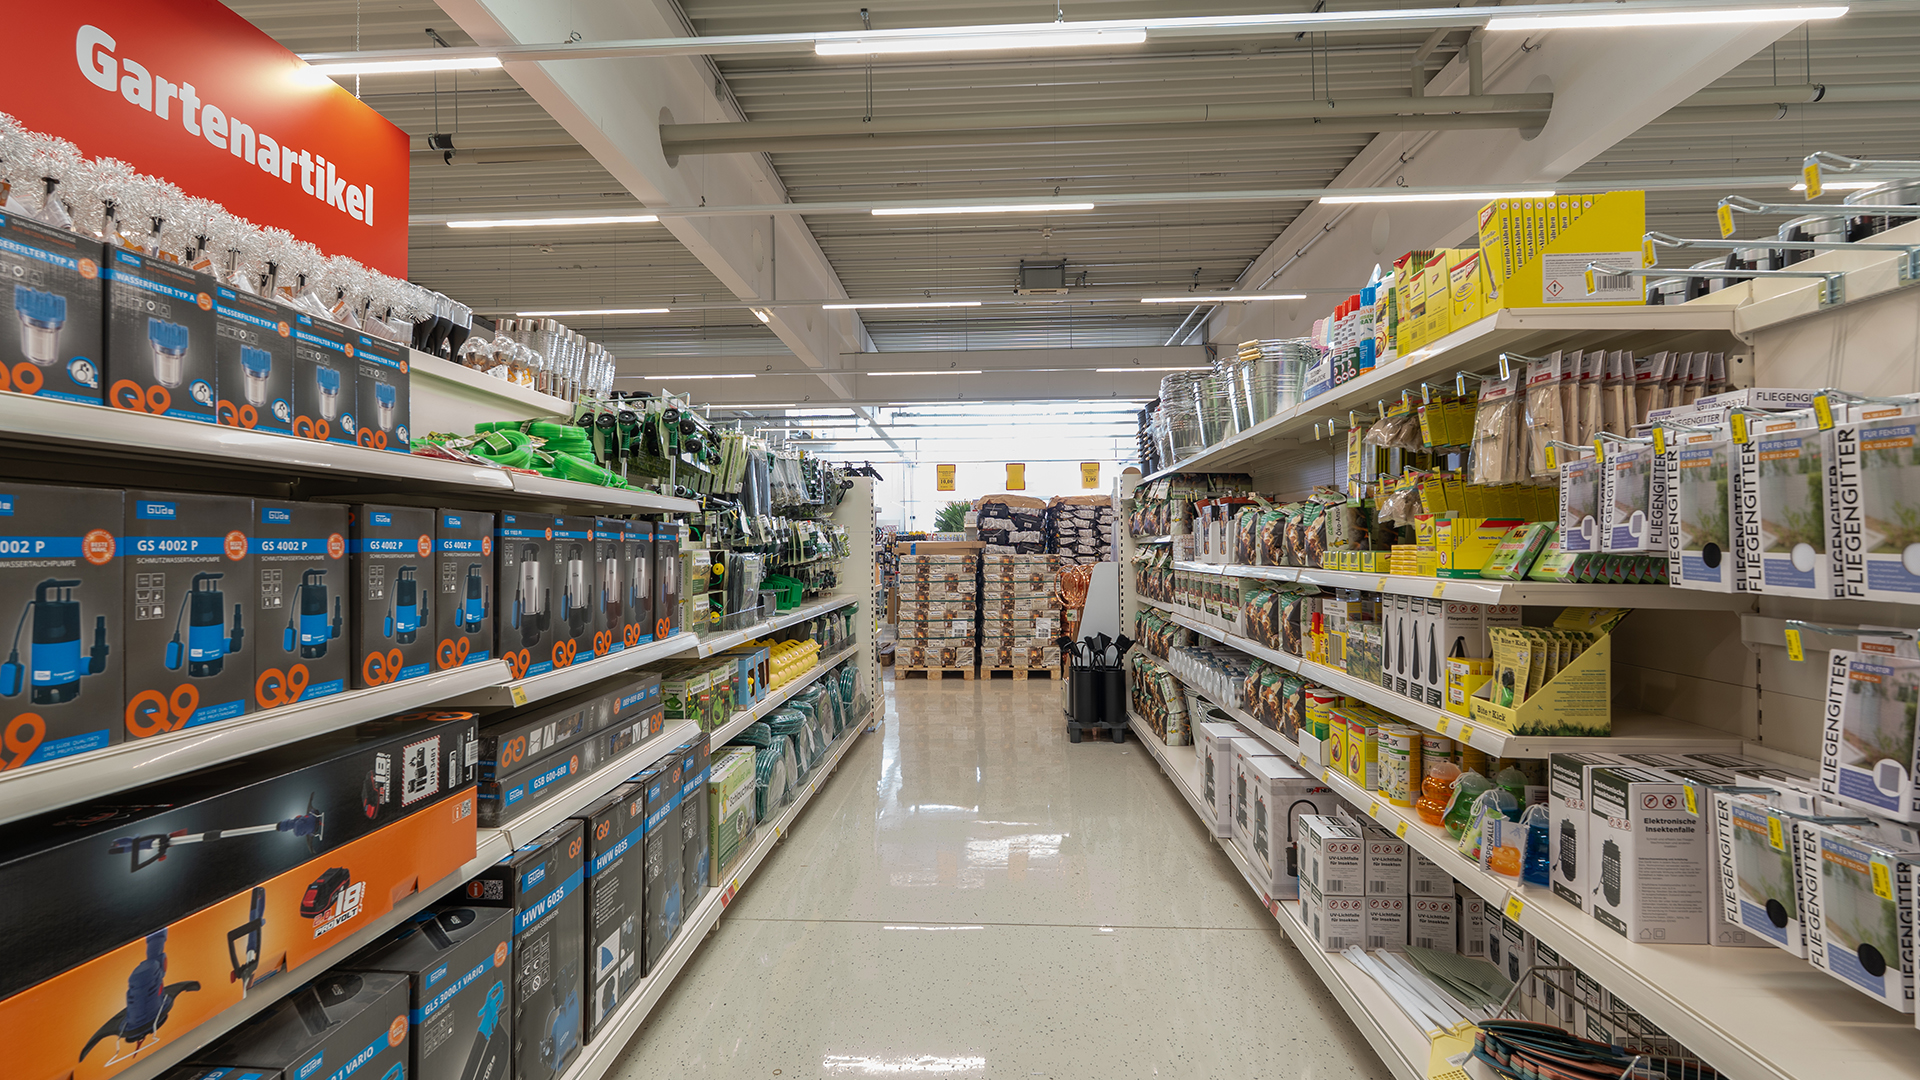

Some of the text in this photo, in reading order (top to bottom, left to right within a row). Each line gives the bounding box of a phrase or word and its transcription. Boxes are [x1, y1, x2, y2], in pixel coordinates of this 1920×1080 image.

[76, 24, 374, 227] Gartenartikel
[48, 253, 67, 265] TYP
[68, 260, 76, 268] A
[115, 272, 172, 295] WASSERFILTER
[174, 290, 188, 299] TYP
[217, 306, 260, 326] WASSERFILTER
[260, 320, 271, 328] TYP
[296, 331, 330, 347] WASSERFILTER
[360, 351, 387, 364] WASSERFILTER
[110, 380, 171, 415] Q9
[1756, 391, 1839, 403] FLIEGENGIR
[218, 400, 258, 430] Q9
[294, 416, 330, 441] Q9
[1878, 427, 1910, 436] FENSTER
[1604, 456, 1615, 548] FLIEGENGITTER
[1650, 452, 1666, 544] FLIEGENGITTER
[1667, 450, 1681, 586] FLIEGENGITTER
[1742, 440, 1762, 592] FLIEGENGITTER
[1838, 427, 1864, 597] FLIEGENGITTER
[35, 540, 45, 554] P
[137, 540, 198, 551] GS 4002 P
[262, 541, 308, 551] GS 4002 P
[370, 541, 380, 550] GS
[381, 541, 396, 550] 4002
[444, 541, 452, 549] GS
[624, 623, 641, 647] Q9
[656, 617, 670, 640] Q9
[437, 636, 470, 669] Q9
[552, 638, 577, 668] Q9
[594, 630, 612, 656] Q9
[363, 648, 403, 686] Q9
[255, 664, 309, 708] Q9
[126, 683, 200, 738] Q9
[650, 712, 662, 734] Q9
[1477, 705, 1506, 722] Bite Kick
[1822, 654, 1847, 794] FLIEGENGITTER
[0, 712, 46, 772] 9
[430, 770, 436, 785] UN
[534, 765, 567, 789] GSB 600-680
[1553, 764, 1580, 779] Elektronische
[1553, 772, 1580, 787] Insektenfalle
[684, 781, 694, 794] HWW
[1594, 780, 1626, 797] Elektronische
[1594, 788, 1625, 806] Insektenfalle
[648, 813, 660, 828] HWW
[661, 802, 670, 818] 6035
[1747, 811, 1768, 825] FENSTE
[597, 820, 610, 840] Q9
[569, 837, 582, 858] Q9
[596, 838, 628, 870] HWW 6035
[1486, 821, 1494, 870] WESPENFALLE
[1838, 844, 1869, 861] FENSTER
[1717, 799, 1739, 924] FLIEGENGITTER
[335, 881, 362, 917] 18
[522, 886, 564, 928] HWW 6035
[1803, 829, 1824, 968] FLIEGENGITTER
[334, 906, 358, 927] VOLT
[521, 908, 559, 940] HAUSWASSERWERK
[1897, 862, 1914, 1000] FLIEGENGITTER
[425, 965, 484, 1016] GLS 3000.1 VARIO
[346, 1046, 374, 1075] VARIO
